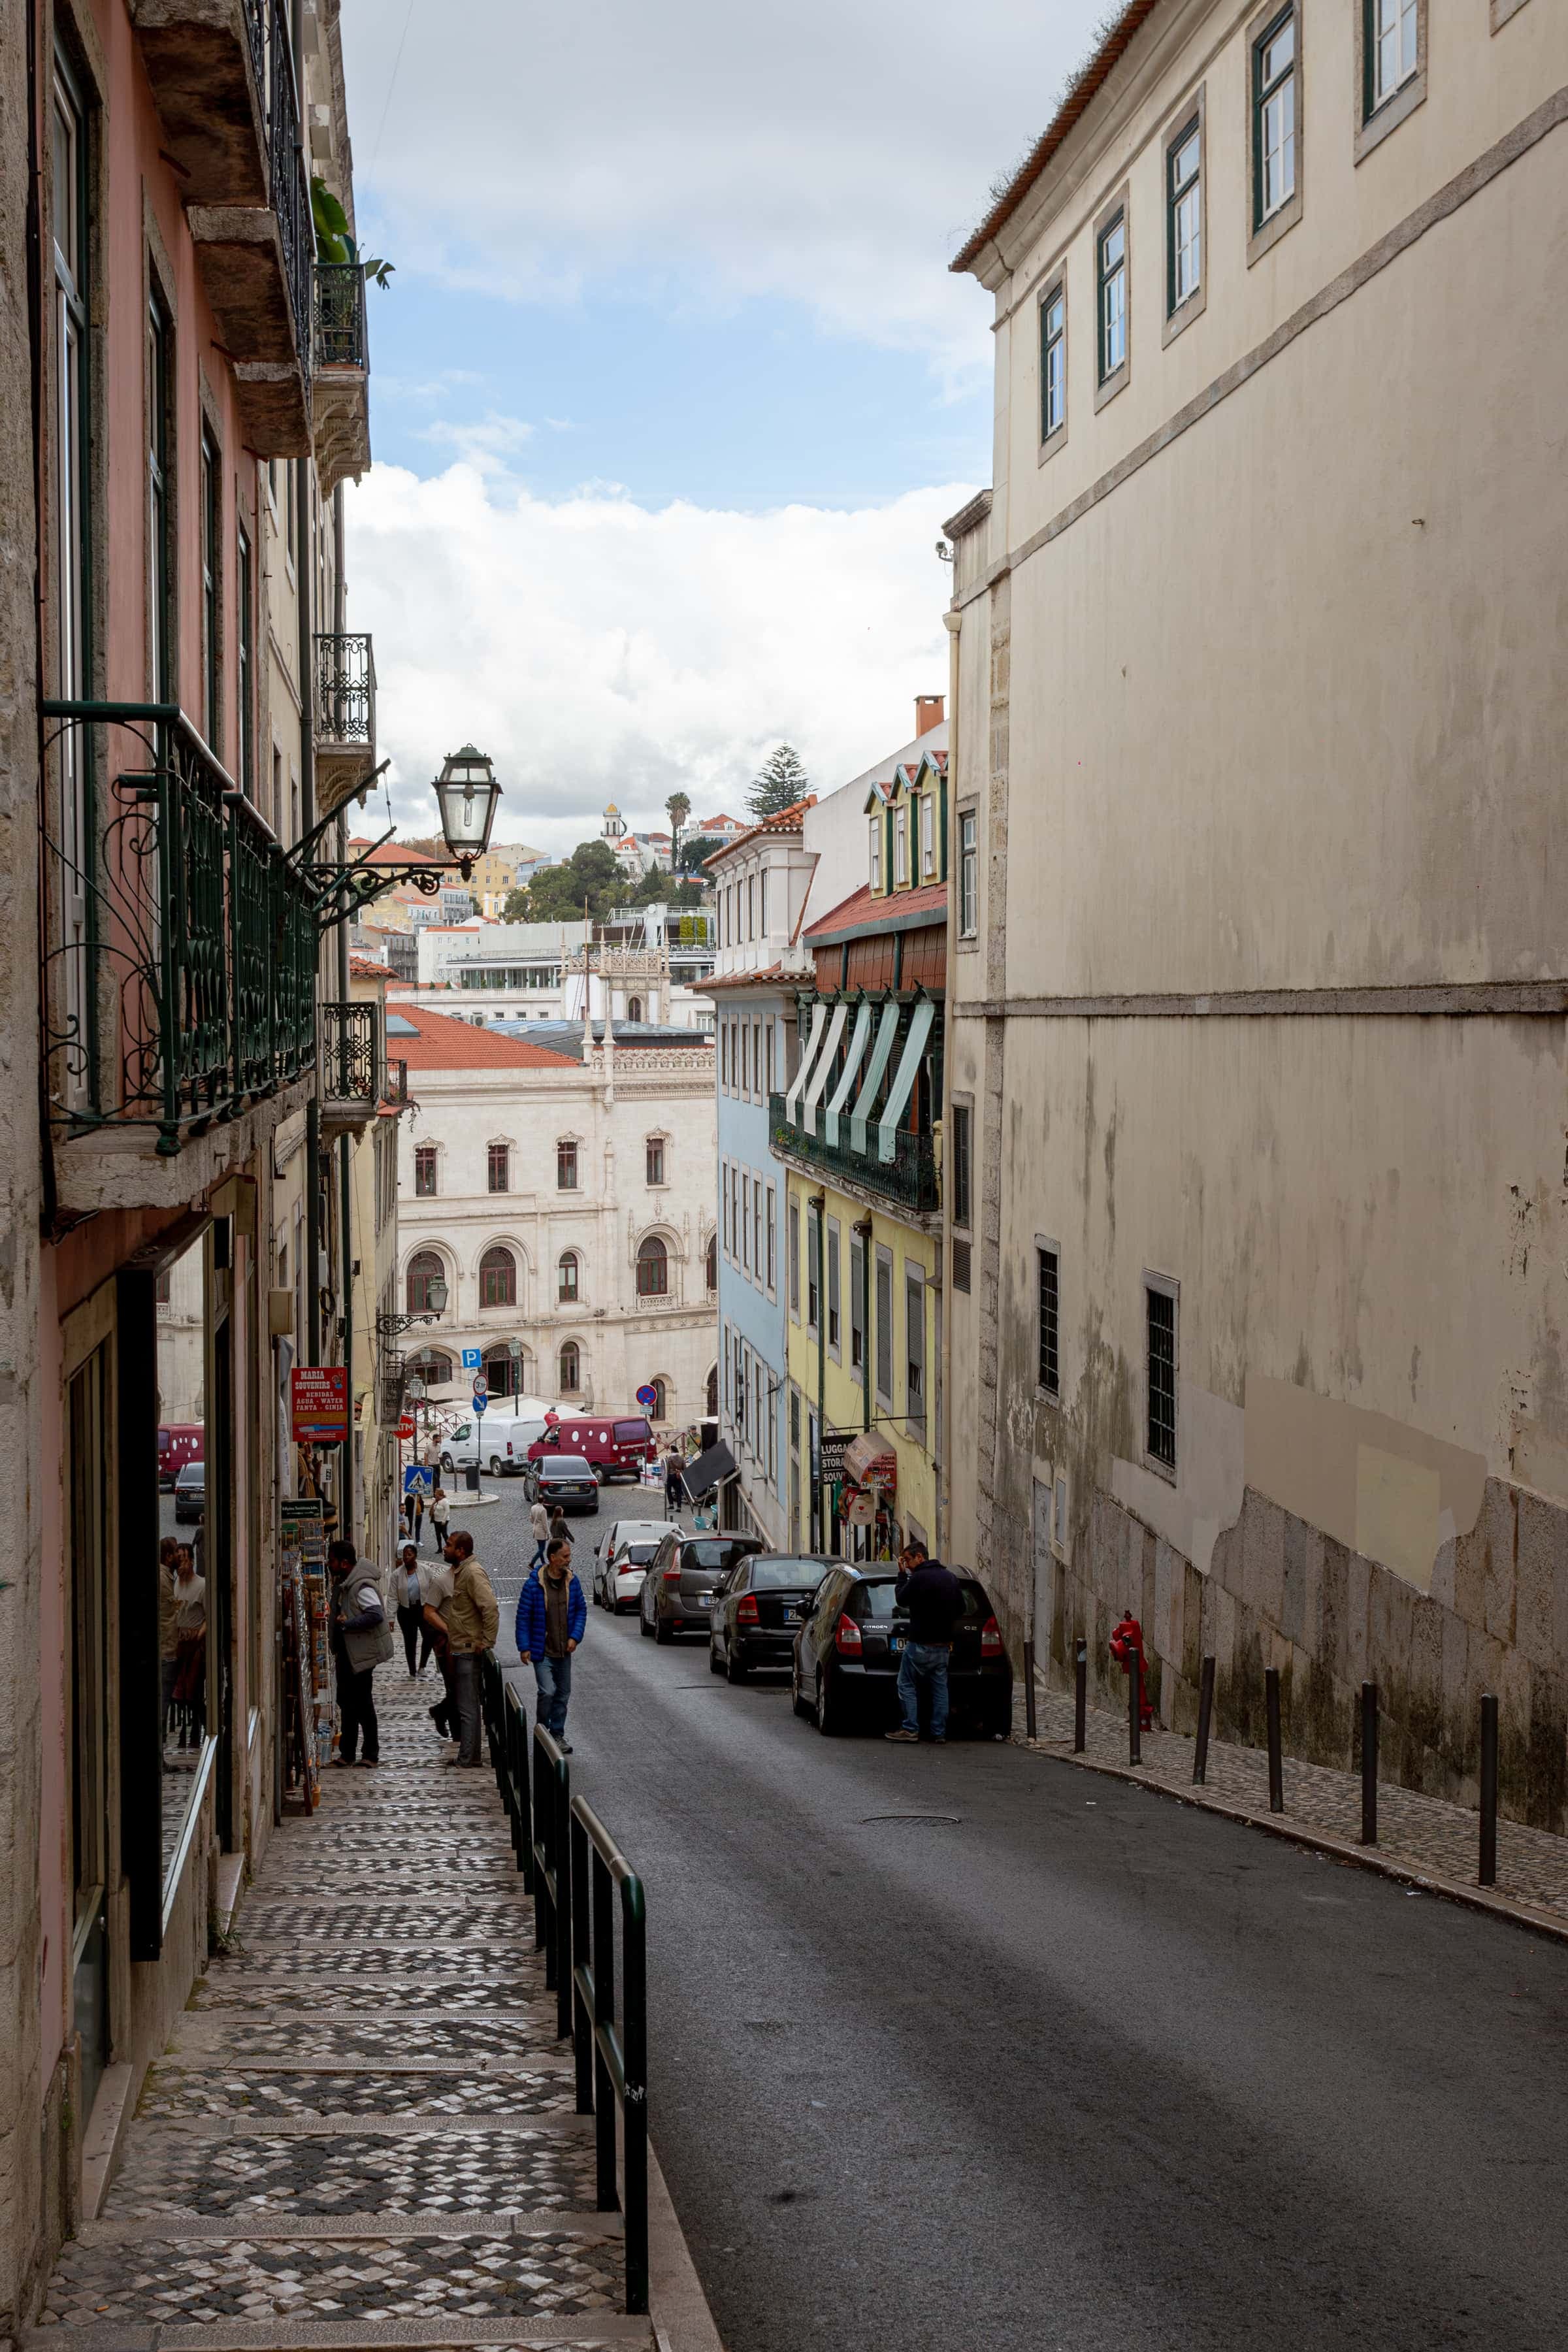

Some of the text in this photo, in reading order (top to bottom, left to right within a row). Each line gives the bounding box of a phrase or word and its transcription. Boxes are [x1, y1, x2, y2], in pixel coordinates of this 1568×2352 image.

[466, 1351, 476, 1366] P
[301, 1371, 324, 1380] MARIA
[295, 1381, 330, 1390] SOUVENIRS
